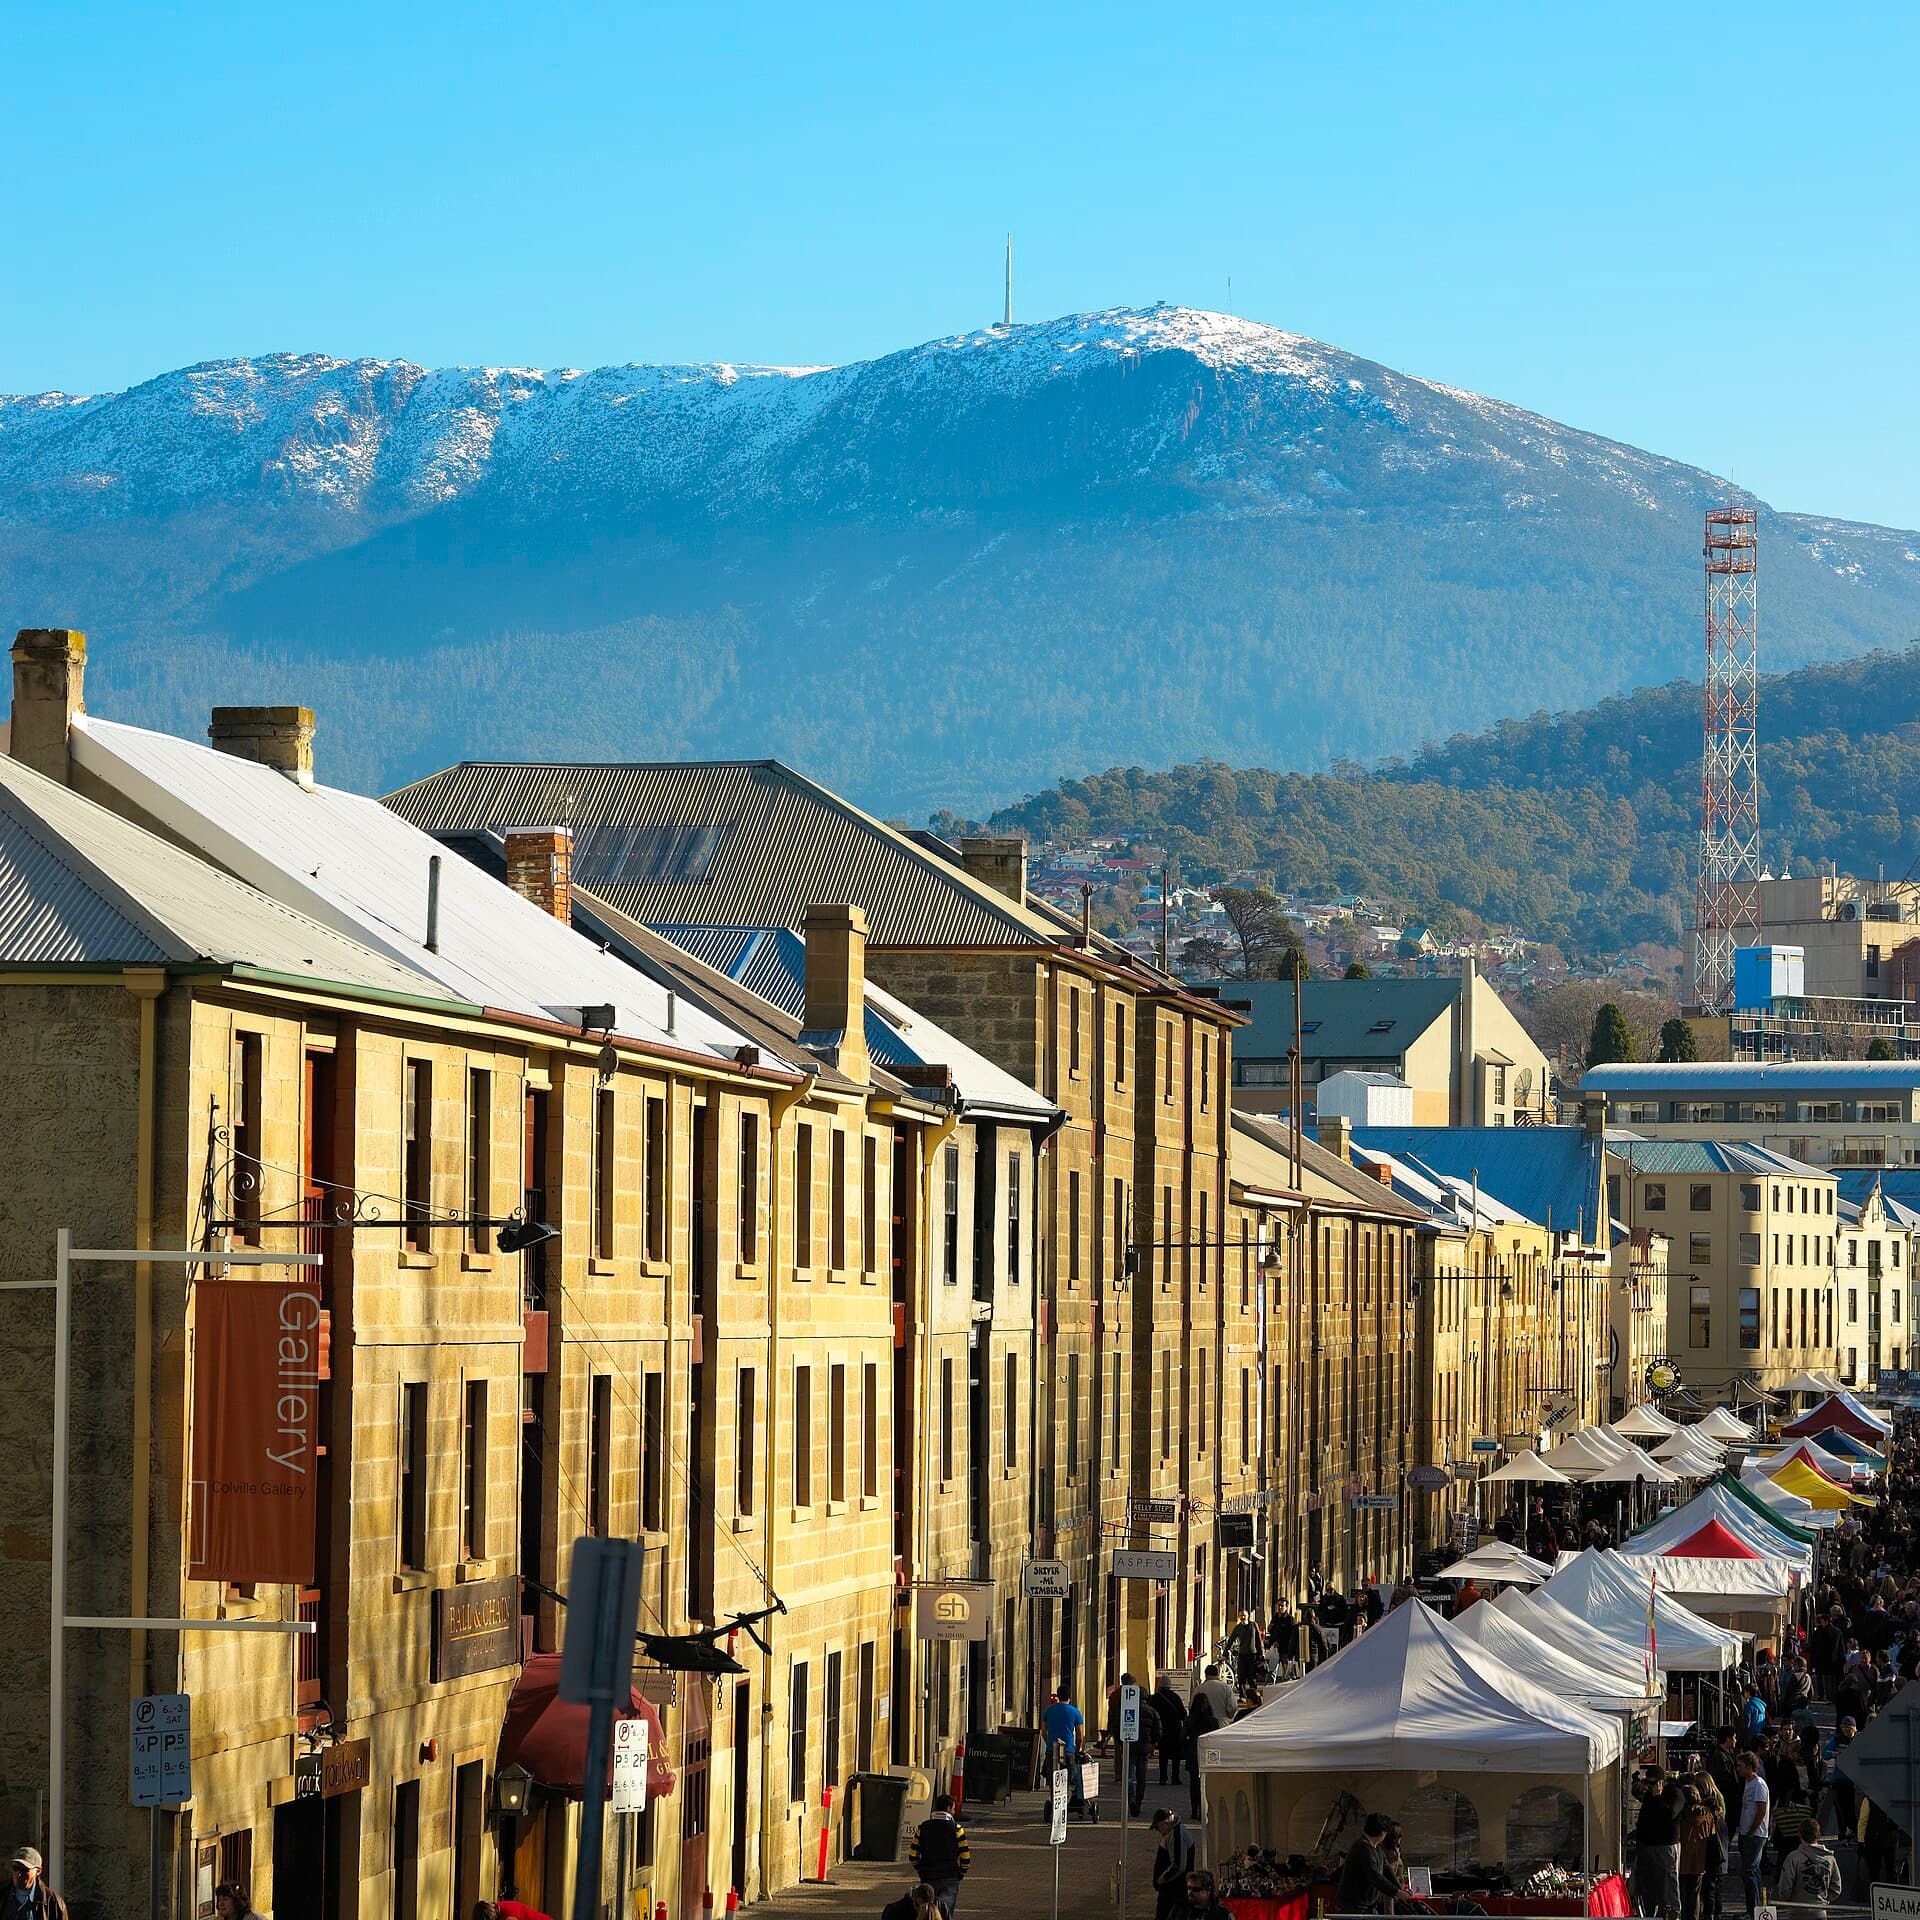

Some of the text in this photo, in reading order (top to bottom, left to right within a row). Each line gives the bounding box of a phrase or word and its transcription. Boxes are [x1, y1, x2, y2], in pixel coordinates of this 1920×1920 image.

[265, 1291, 321, 1474] Gallery
[1545, 1405, 1569, 1428] grape
[212, 1480, 306, 1499] Colville Gallery
[1133, 1504, 1152, 1512] KELLY
[1117, 1557, 1172, 1569] ASPECT
[1033, 1566, 1060, 1575] SHIVER
[1030, 1586, 1064, 1595] TIMBERS
[449, 1595, 511, 1633] BALL & CHAIN
[937, 1597, 965, 1618] sh
[1125, 1687, 1136, 1700] 1P
[166, 1715, 181, 1725] SAT
[633, 1753, 646, 1768] 2P
